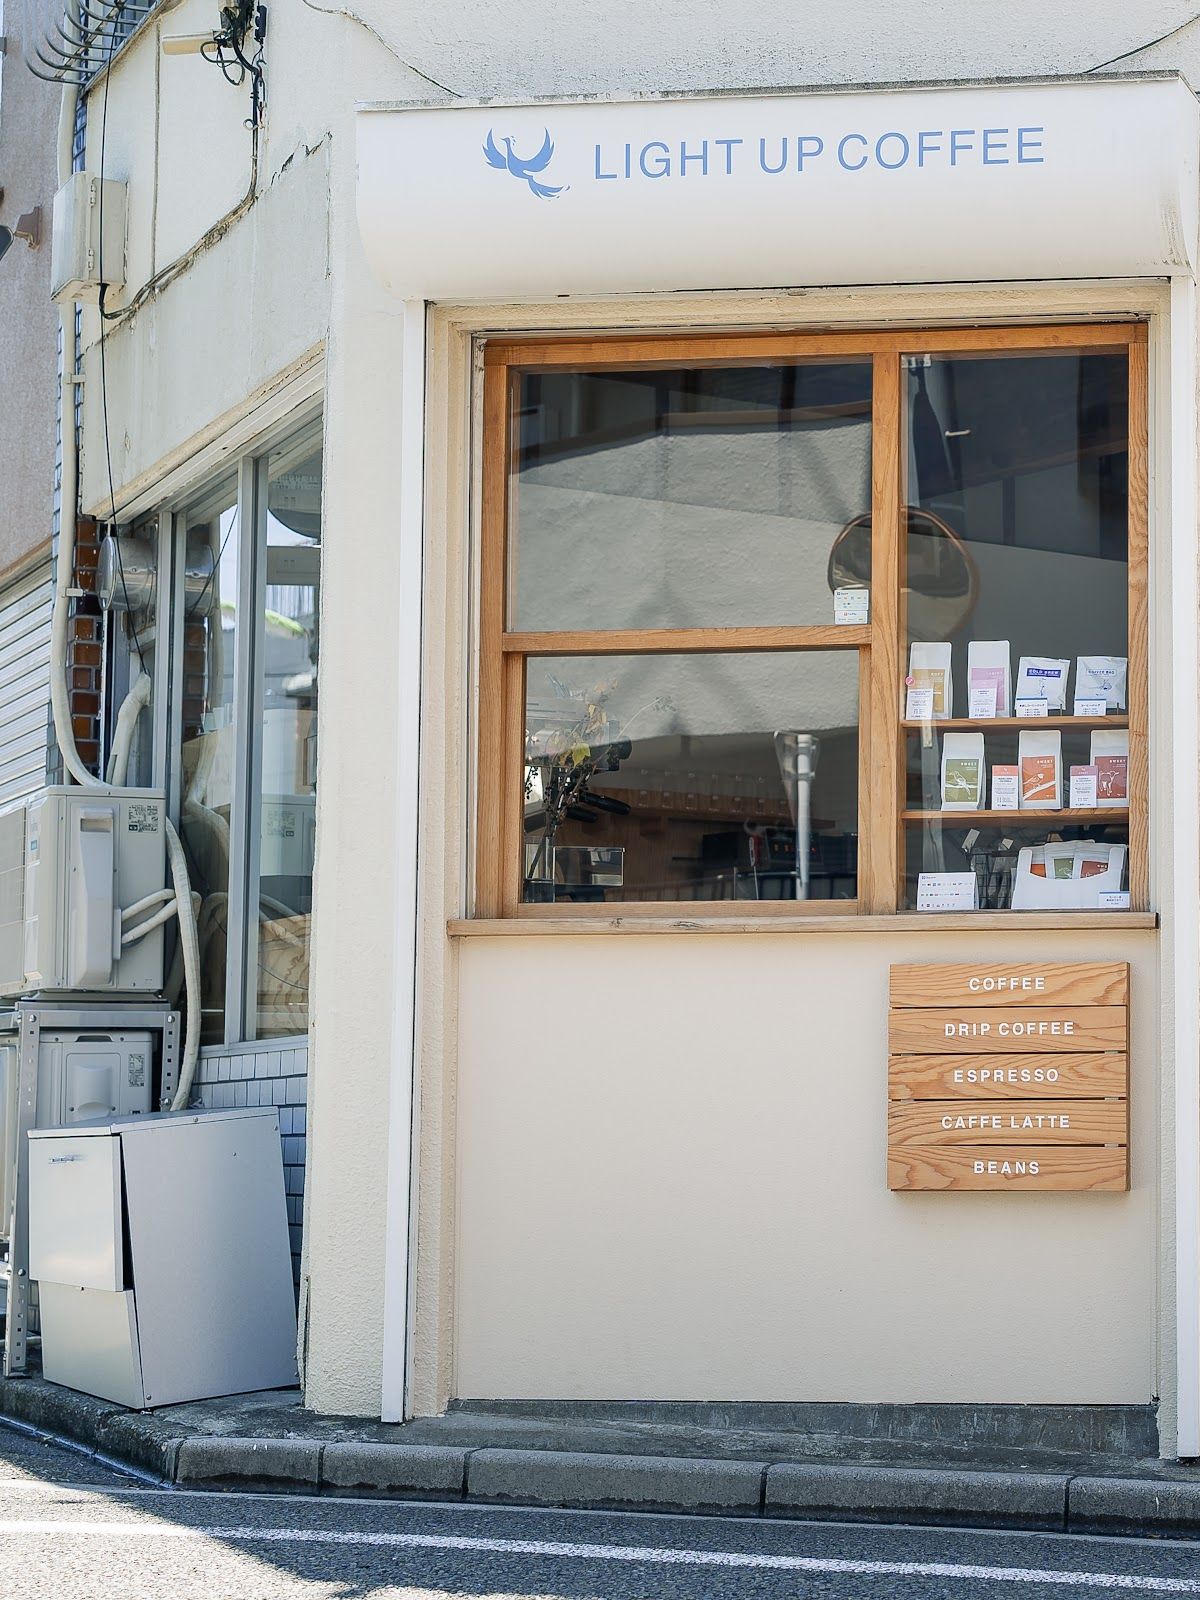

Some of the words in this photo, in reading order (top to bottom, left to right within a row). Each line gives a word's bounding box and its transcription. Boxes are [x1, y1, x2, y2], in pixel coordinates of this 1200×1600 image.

[595, 138, 743, 180] LIGHT
[759, 136, 824, 174] UP
[837, 127, 1045, 171] COFFEE
[969, 977, 1045, 991] COFFEE
[944, 1023, 991, 1036] DRIP
[998, 1021, 1074, 1036] COFFEE
[953, 1068, 1059, 1083] ESPRESSO
[941, 1115, 1002, 1129] CAFFE
[1010, 1115, 1070, 1128] LATTE
[973, 1161, 1040, 1175] BEANS
